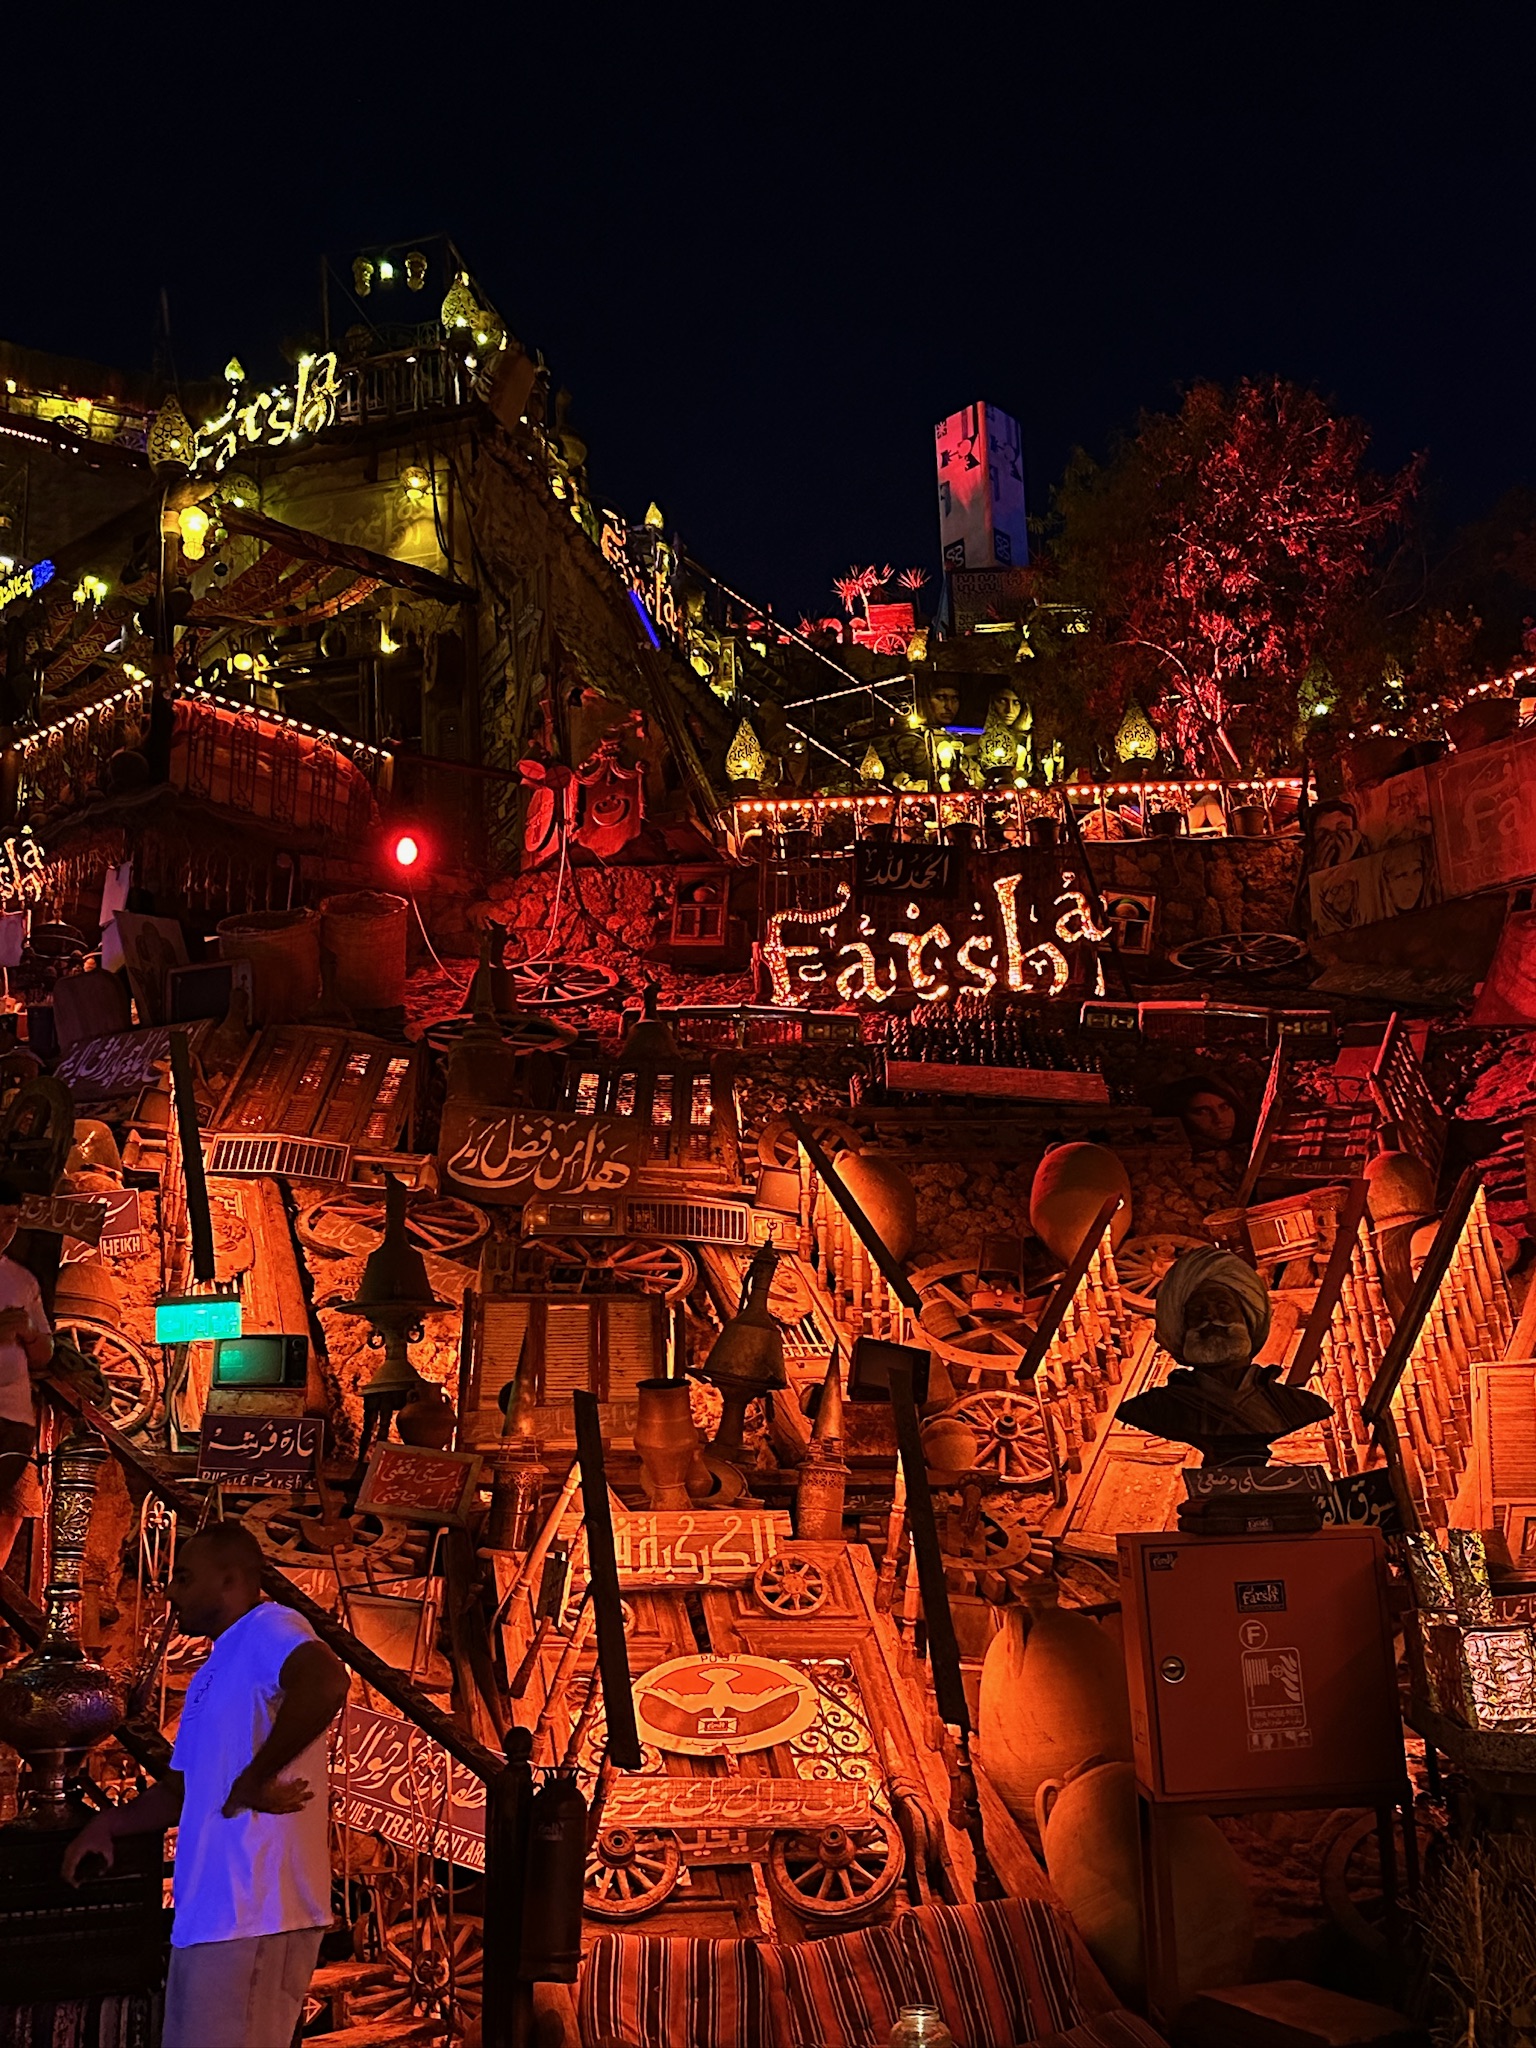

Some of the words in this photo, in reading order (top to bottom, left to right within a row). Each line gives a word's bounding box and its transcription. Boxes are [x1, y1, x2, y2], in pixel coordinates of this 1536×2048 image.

[763, 872, 1112, 1006] Farsha
[480, 1114, 556, 1180] فضل
[532, 1138, 586, 1191] من
[700, 1654, 741, 1664] POST
[1246, 1625, 1261, 1645] F
